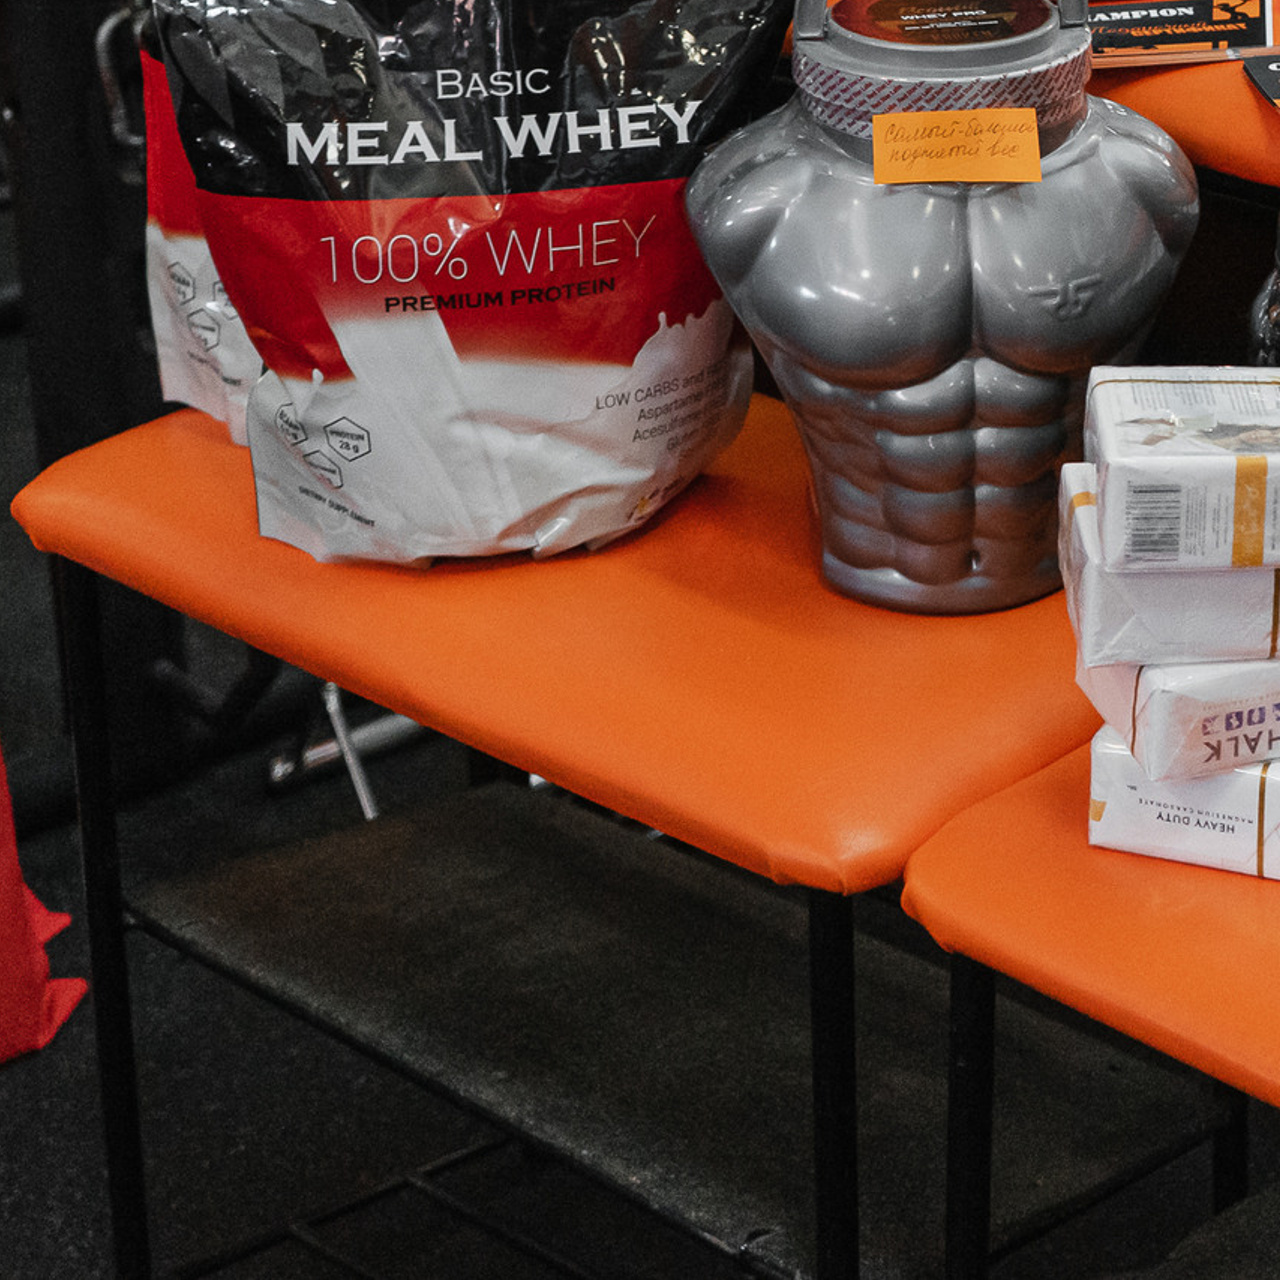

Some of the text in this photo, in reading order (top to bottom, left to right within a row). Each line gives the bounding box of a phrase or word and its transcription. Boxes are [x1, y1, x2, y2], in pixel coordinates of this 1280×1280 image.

[286, 100, 702, 166] MEAL WHEY
[320, 215, 657, 284] 100% WHEY
[384, 276, 616, 314] PREMIUM PROTEIN
[595, 391, 632, 411] LOW
[634, 377, 680, 404] CARBS
[329, 429, 366, 442] PROTEIN
[1139, 798, 1254, 824] MAGNESIUM CARBONATE
[1156, 811, 1235, 834] HEAVY DUTY
